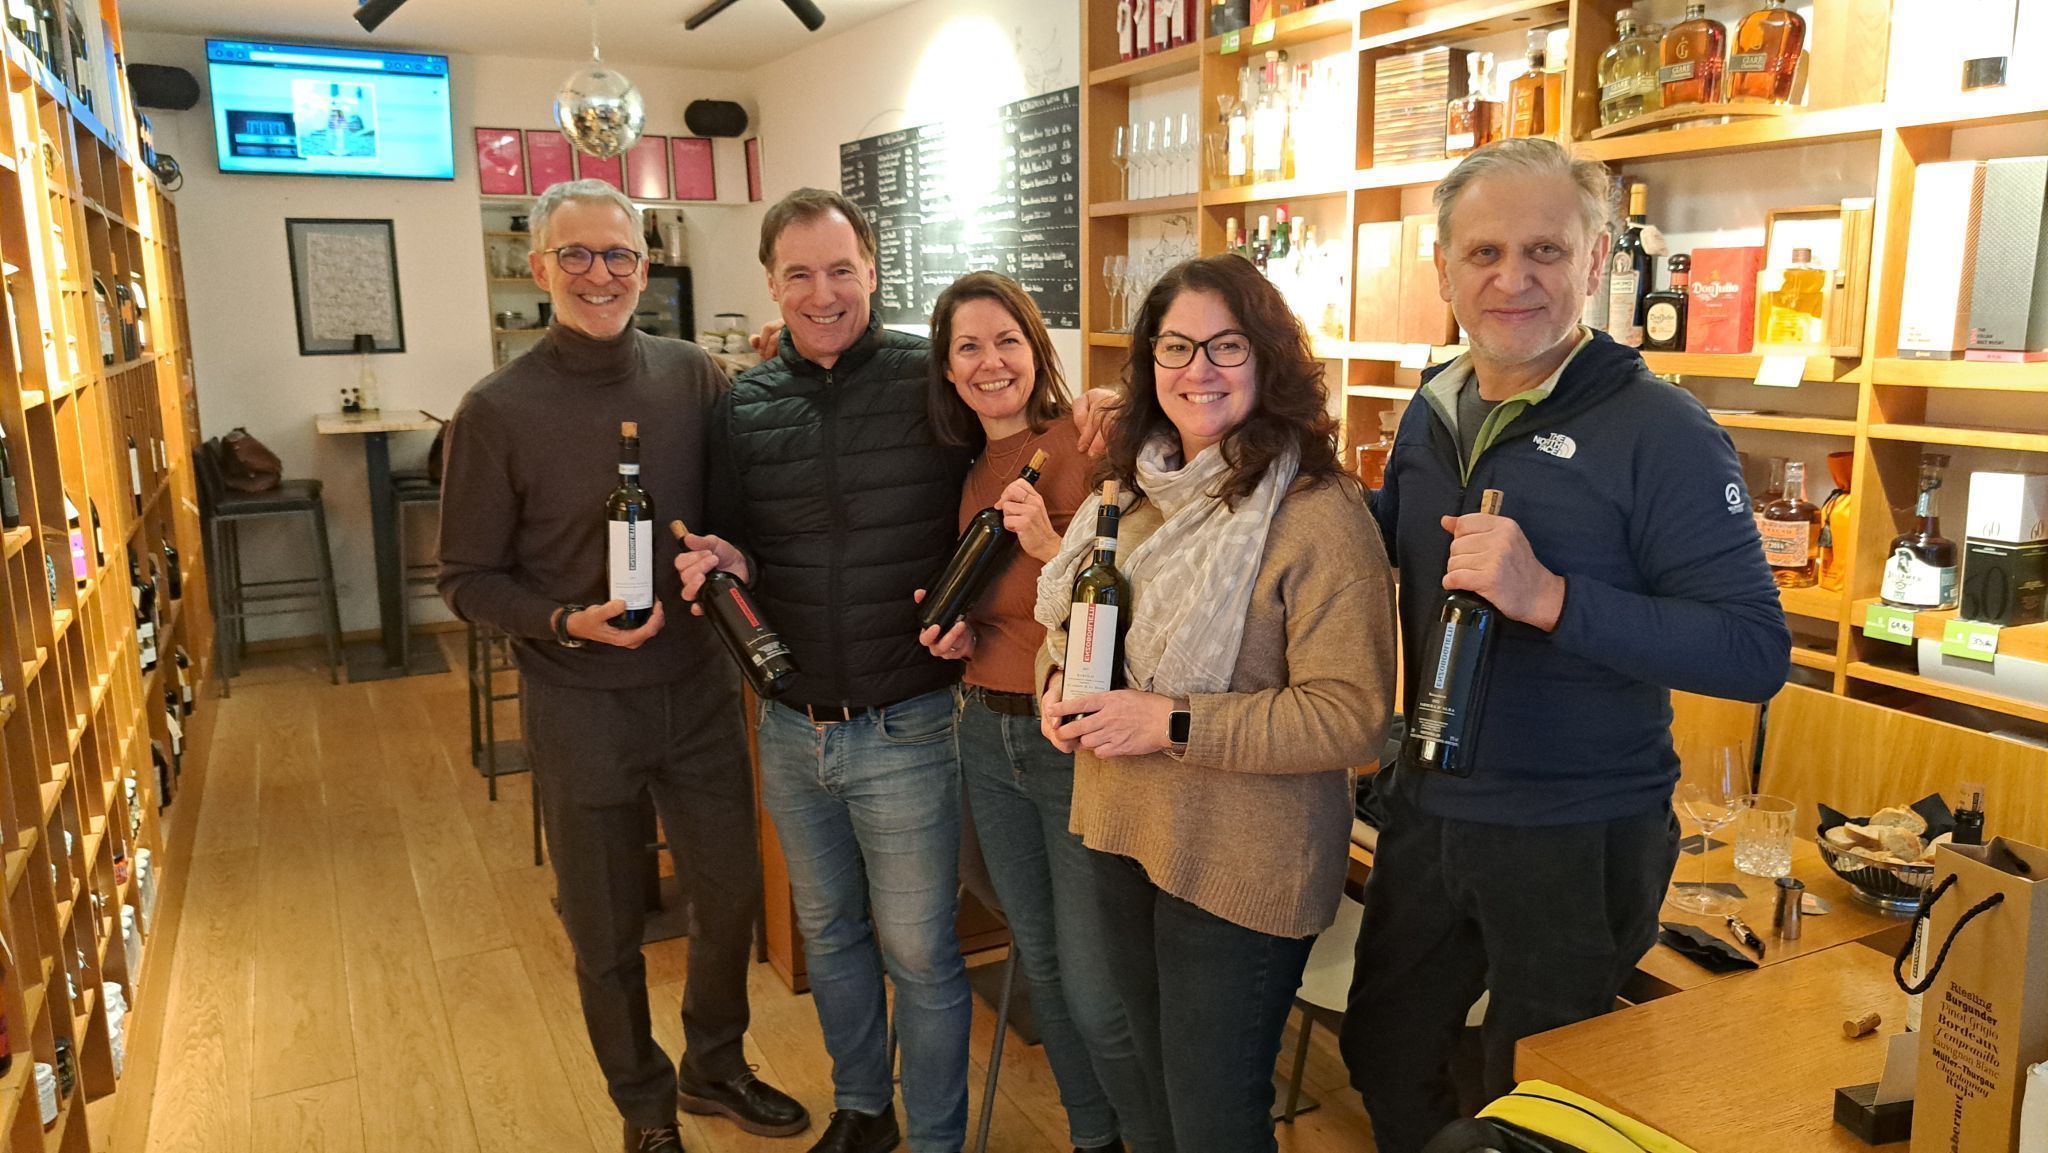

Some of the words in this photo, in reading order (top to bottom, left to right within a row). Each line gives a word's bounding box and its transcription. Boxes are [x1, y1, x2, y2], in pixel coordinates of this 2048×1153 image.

[1692, 282, 1712, 295] Don
[1711, 281, 1739, 298] Julio
[1533, 434, 1563, 450] NORTH
[1536, 444, 1560, 456] FACE
[1550, 432, 1566, 442] THE
[1945, 991, 1998, 1026] Burgunder
[1950, 981, 1993, 1013] Riesling
[1938, 1012, 1999, 1055] Bordeaux
[1940, 1001, 1967, 1024] Pinot
[1969, 1016, 1999, 1040] Grigio
[1933, 1036, 1974, 1065] Sauvignon
[1975, 1061, 2000, 1080] Blanc
[1934, 1025, 2000, 1068] Tempranillo
[1936, 1060, 1990, 1098] Chardonnay
[1946, 1075, 1974, 1099] Rioja
[1949, 1094, 1964, 1153] abernet
